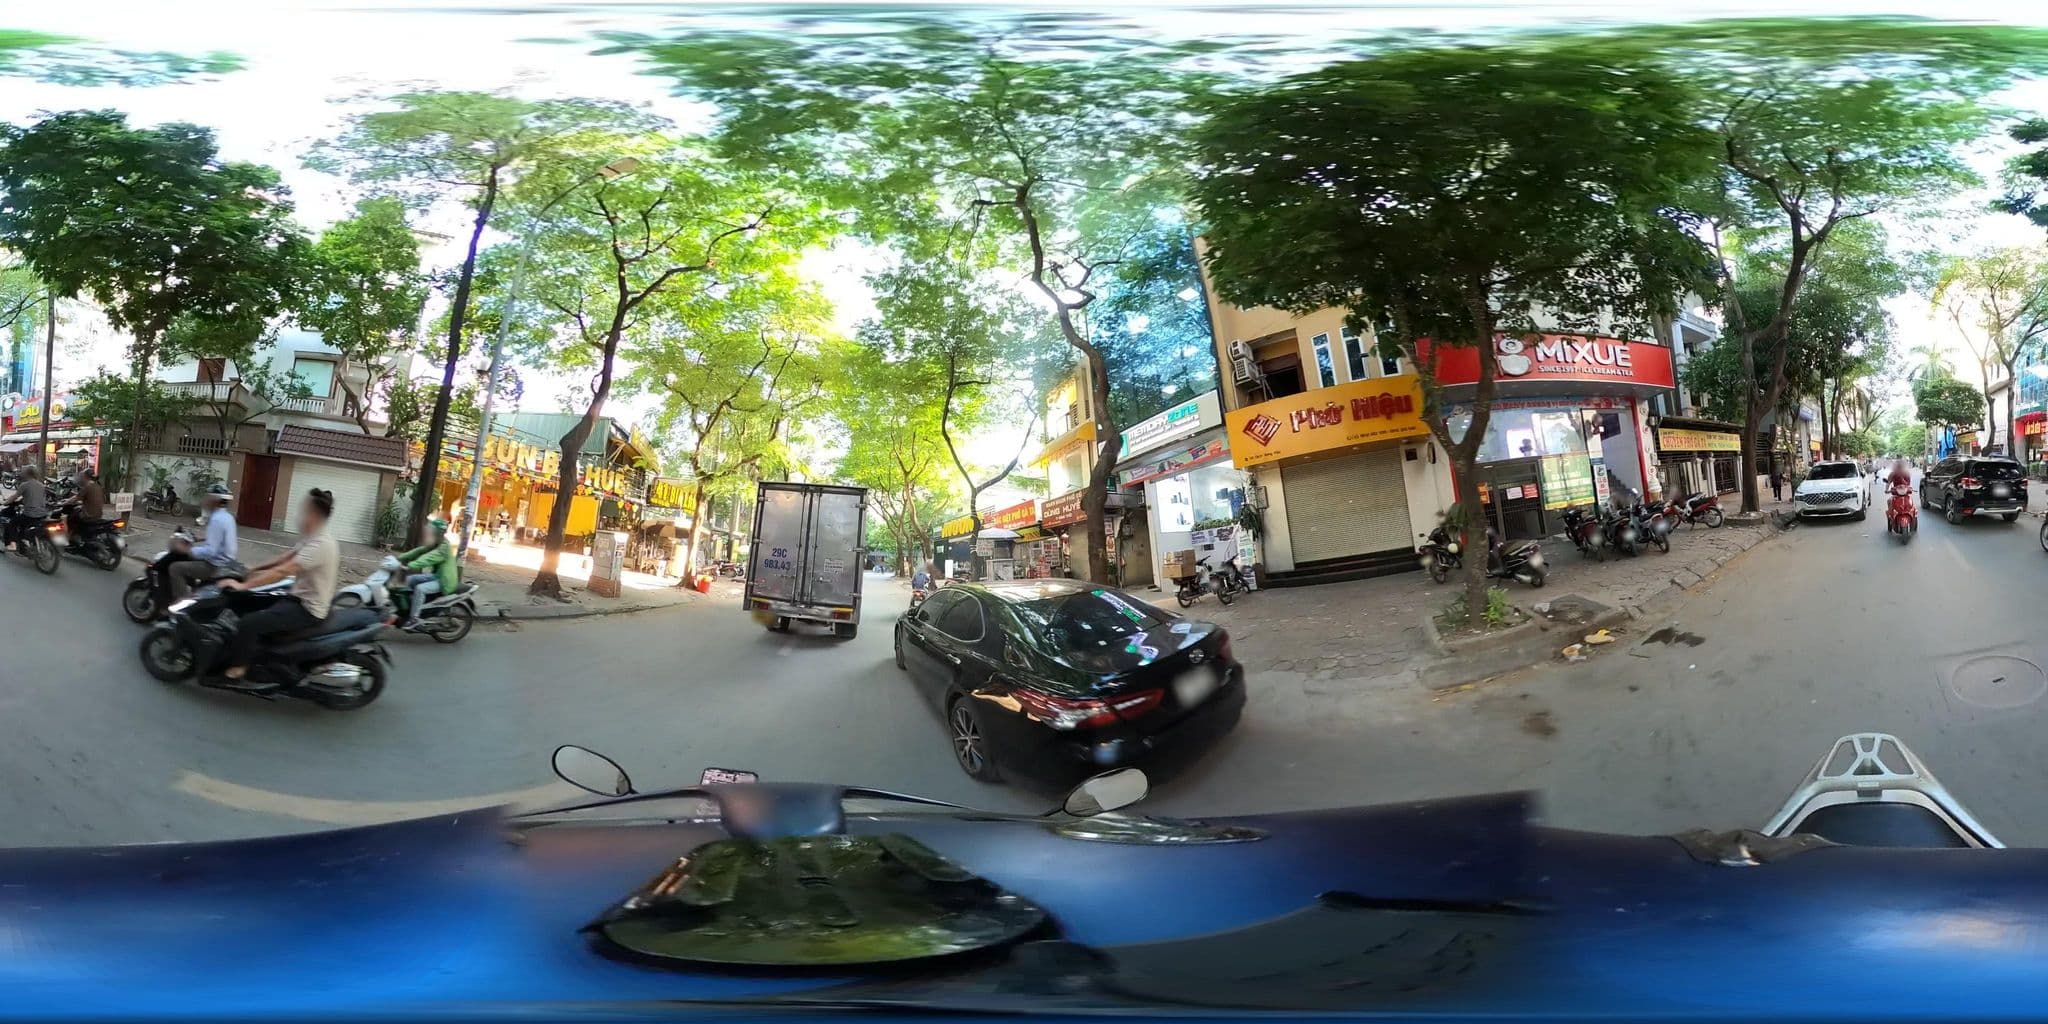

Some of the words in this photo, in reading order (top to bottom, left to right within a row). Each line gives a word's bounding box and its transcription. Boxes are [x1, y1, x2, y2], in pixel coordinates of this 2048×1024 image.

[1535, 339, 1633, 368] MIXUE
[1350, 391, 1414, 422] Hiệu
[771, 547, 788, 558] 29C
[763, 558, 792, 571] 983.43
